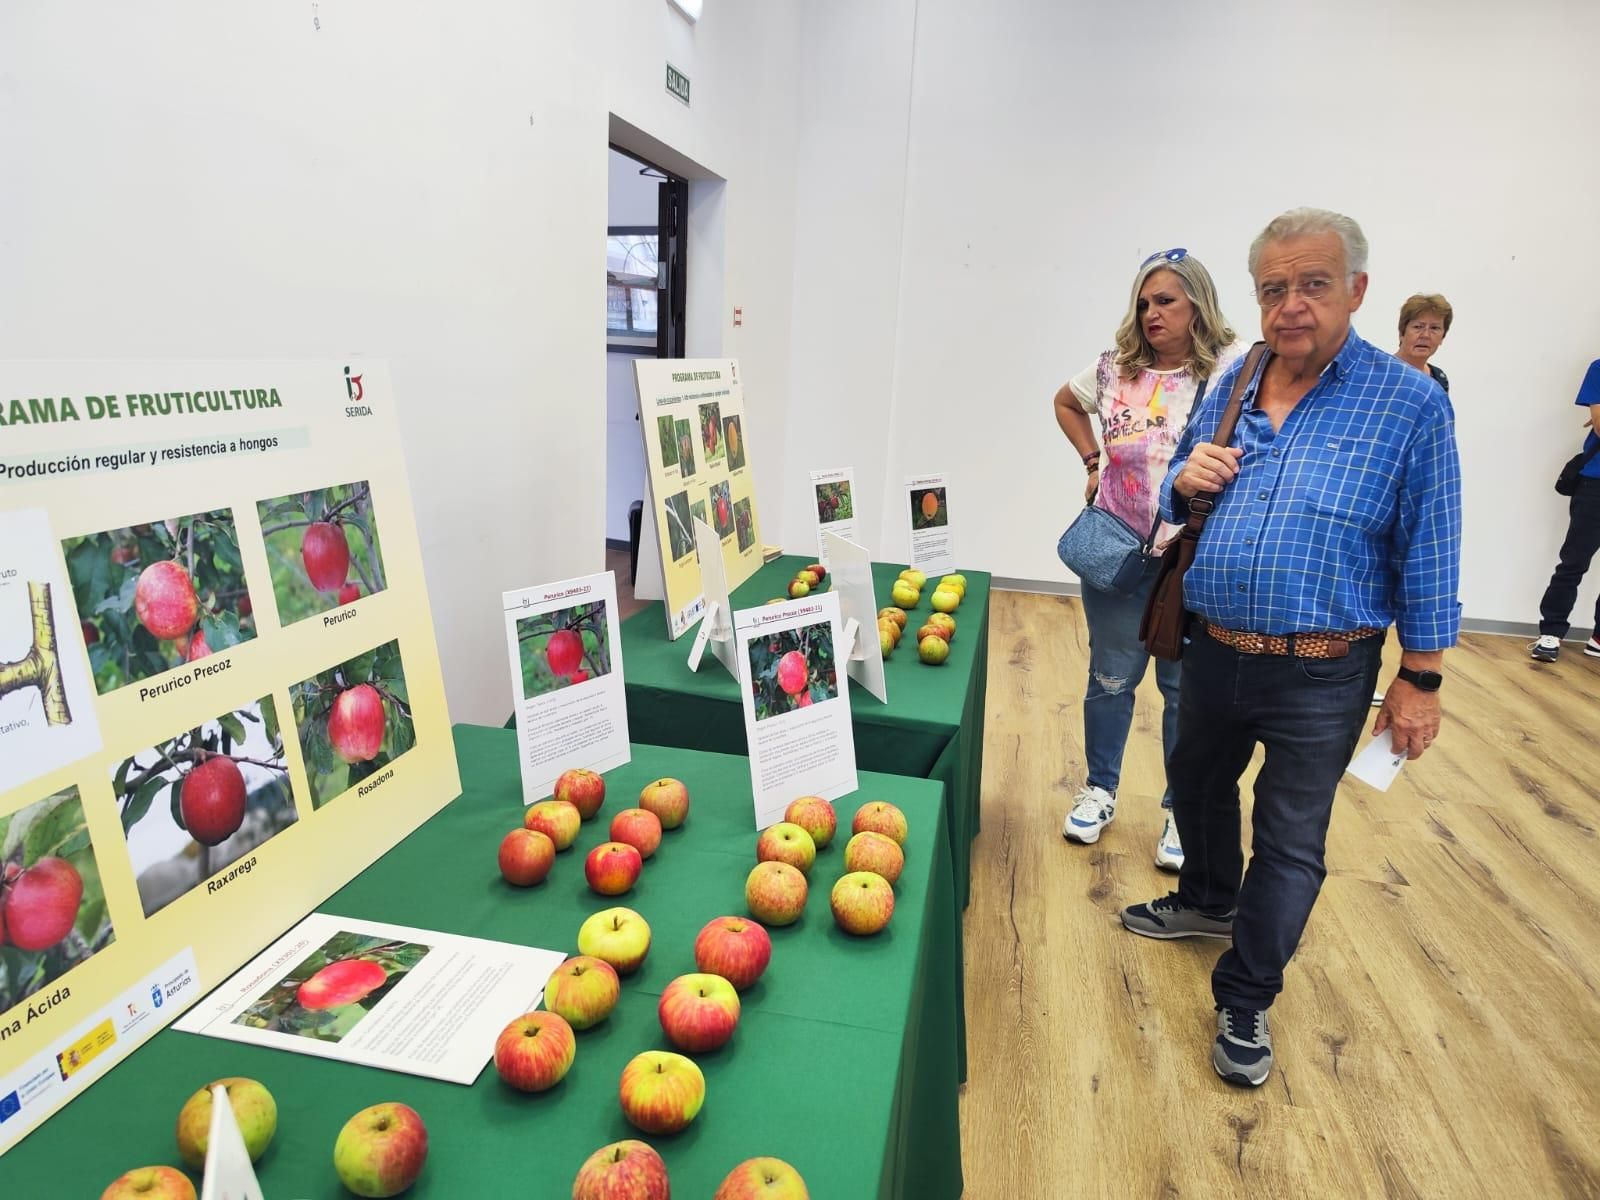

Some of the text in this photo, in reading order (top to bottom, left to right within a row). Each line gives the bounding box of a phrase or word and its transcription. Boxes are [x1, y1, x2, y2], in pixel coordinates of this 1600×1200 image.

[668, 67, 689, 100] SALIDA
[85, 394, 122, 421] DE
[126, 388, 283, 417] FRUTICULTURA
[345, 406, 373, 418] SERIDA
[96, 450, 146, 471] regular
[151, 451, 158, 466] y
[162, 440, 227, 461] resistencia
[230, 442, 238, 452] a
[241, 436, 279, 453] hongos
[323, 608, 357, 627] Perurico
[140, 658, 232, 702] Perurico Precoz
[358, 769, 394, 798] Rosadona
[207, 856, 257, 895] Raxarega
[166, 976, 192, 1000] Asturias
[27, 987, 71, 1024] Ácida
